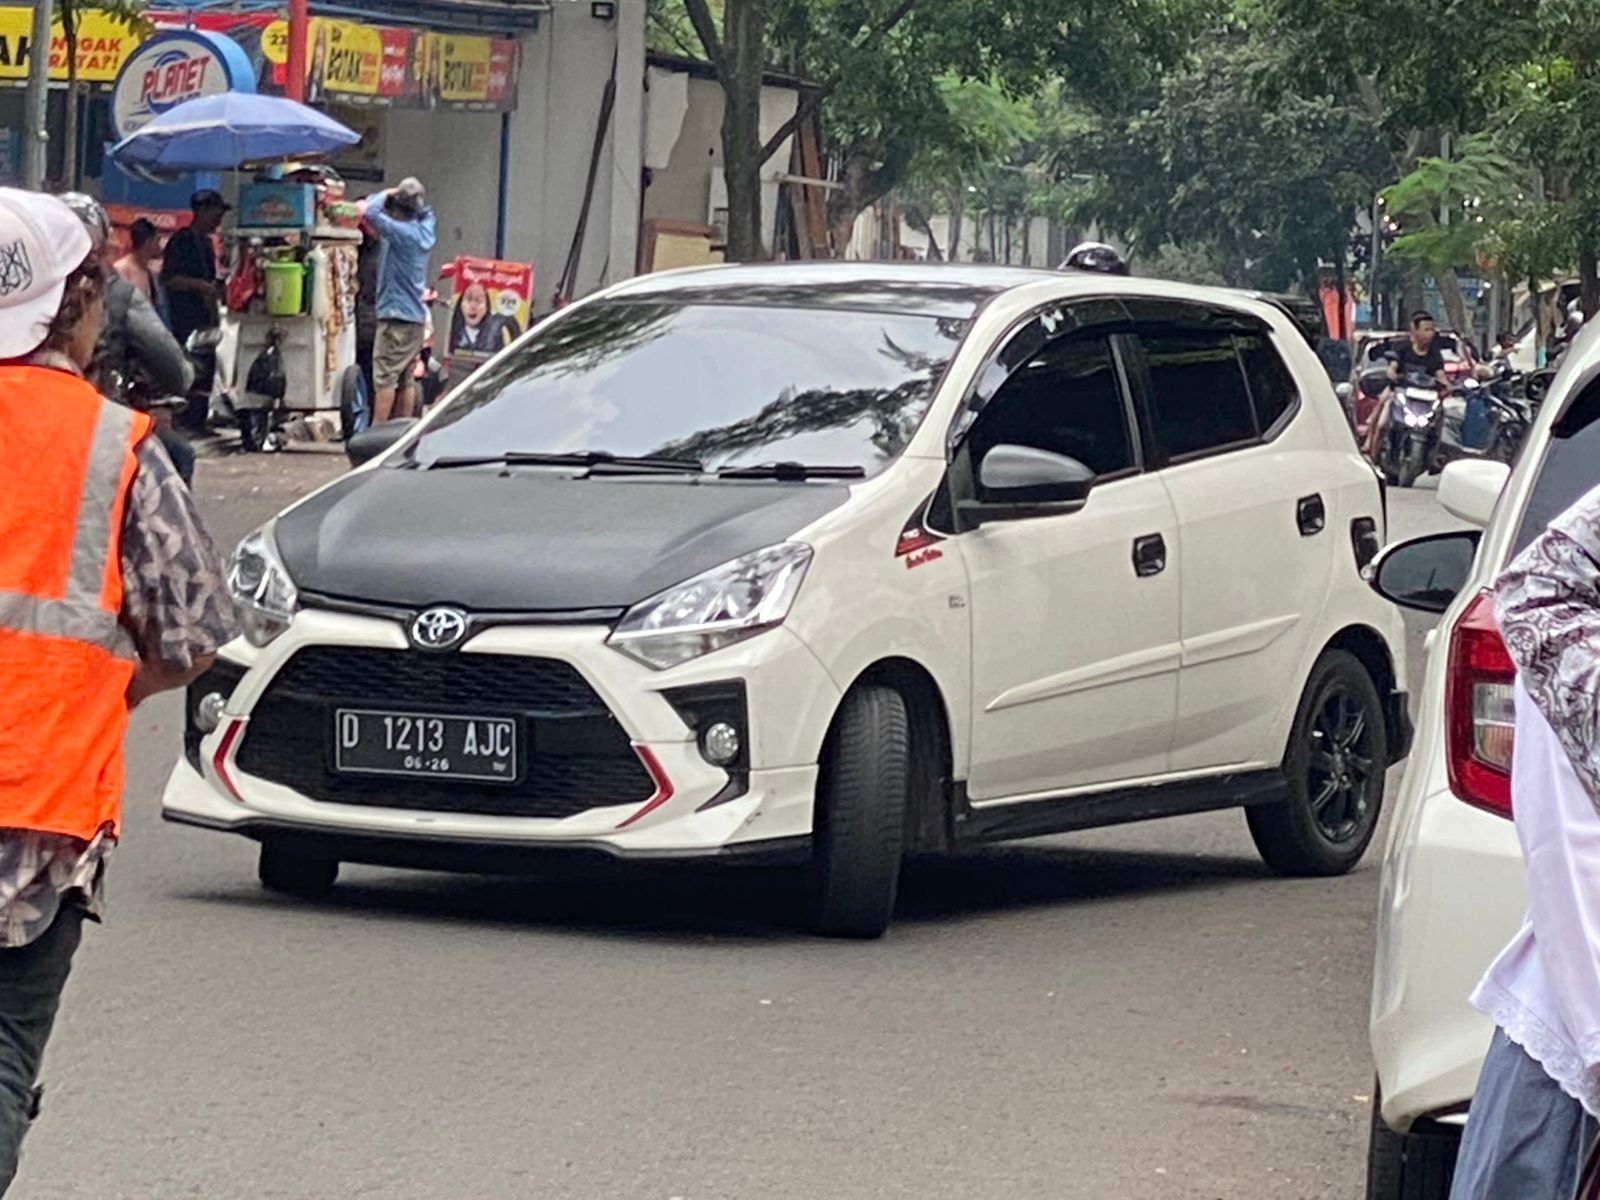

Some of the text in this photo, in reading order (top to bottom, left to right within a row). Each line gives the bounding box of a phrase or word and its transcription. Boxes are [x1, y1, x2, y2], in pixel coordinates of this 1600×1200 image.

[51, 37, 121, 52] NGAK
[141, 57, 210, 102] PLANET
[342, 713, 511, 757] D 1213 AJC
